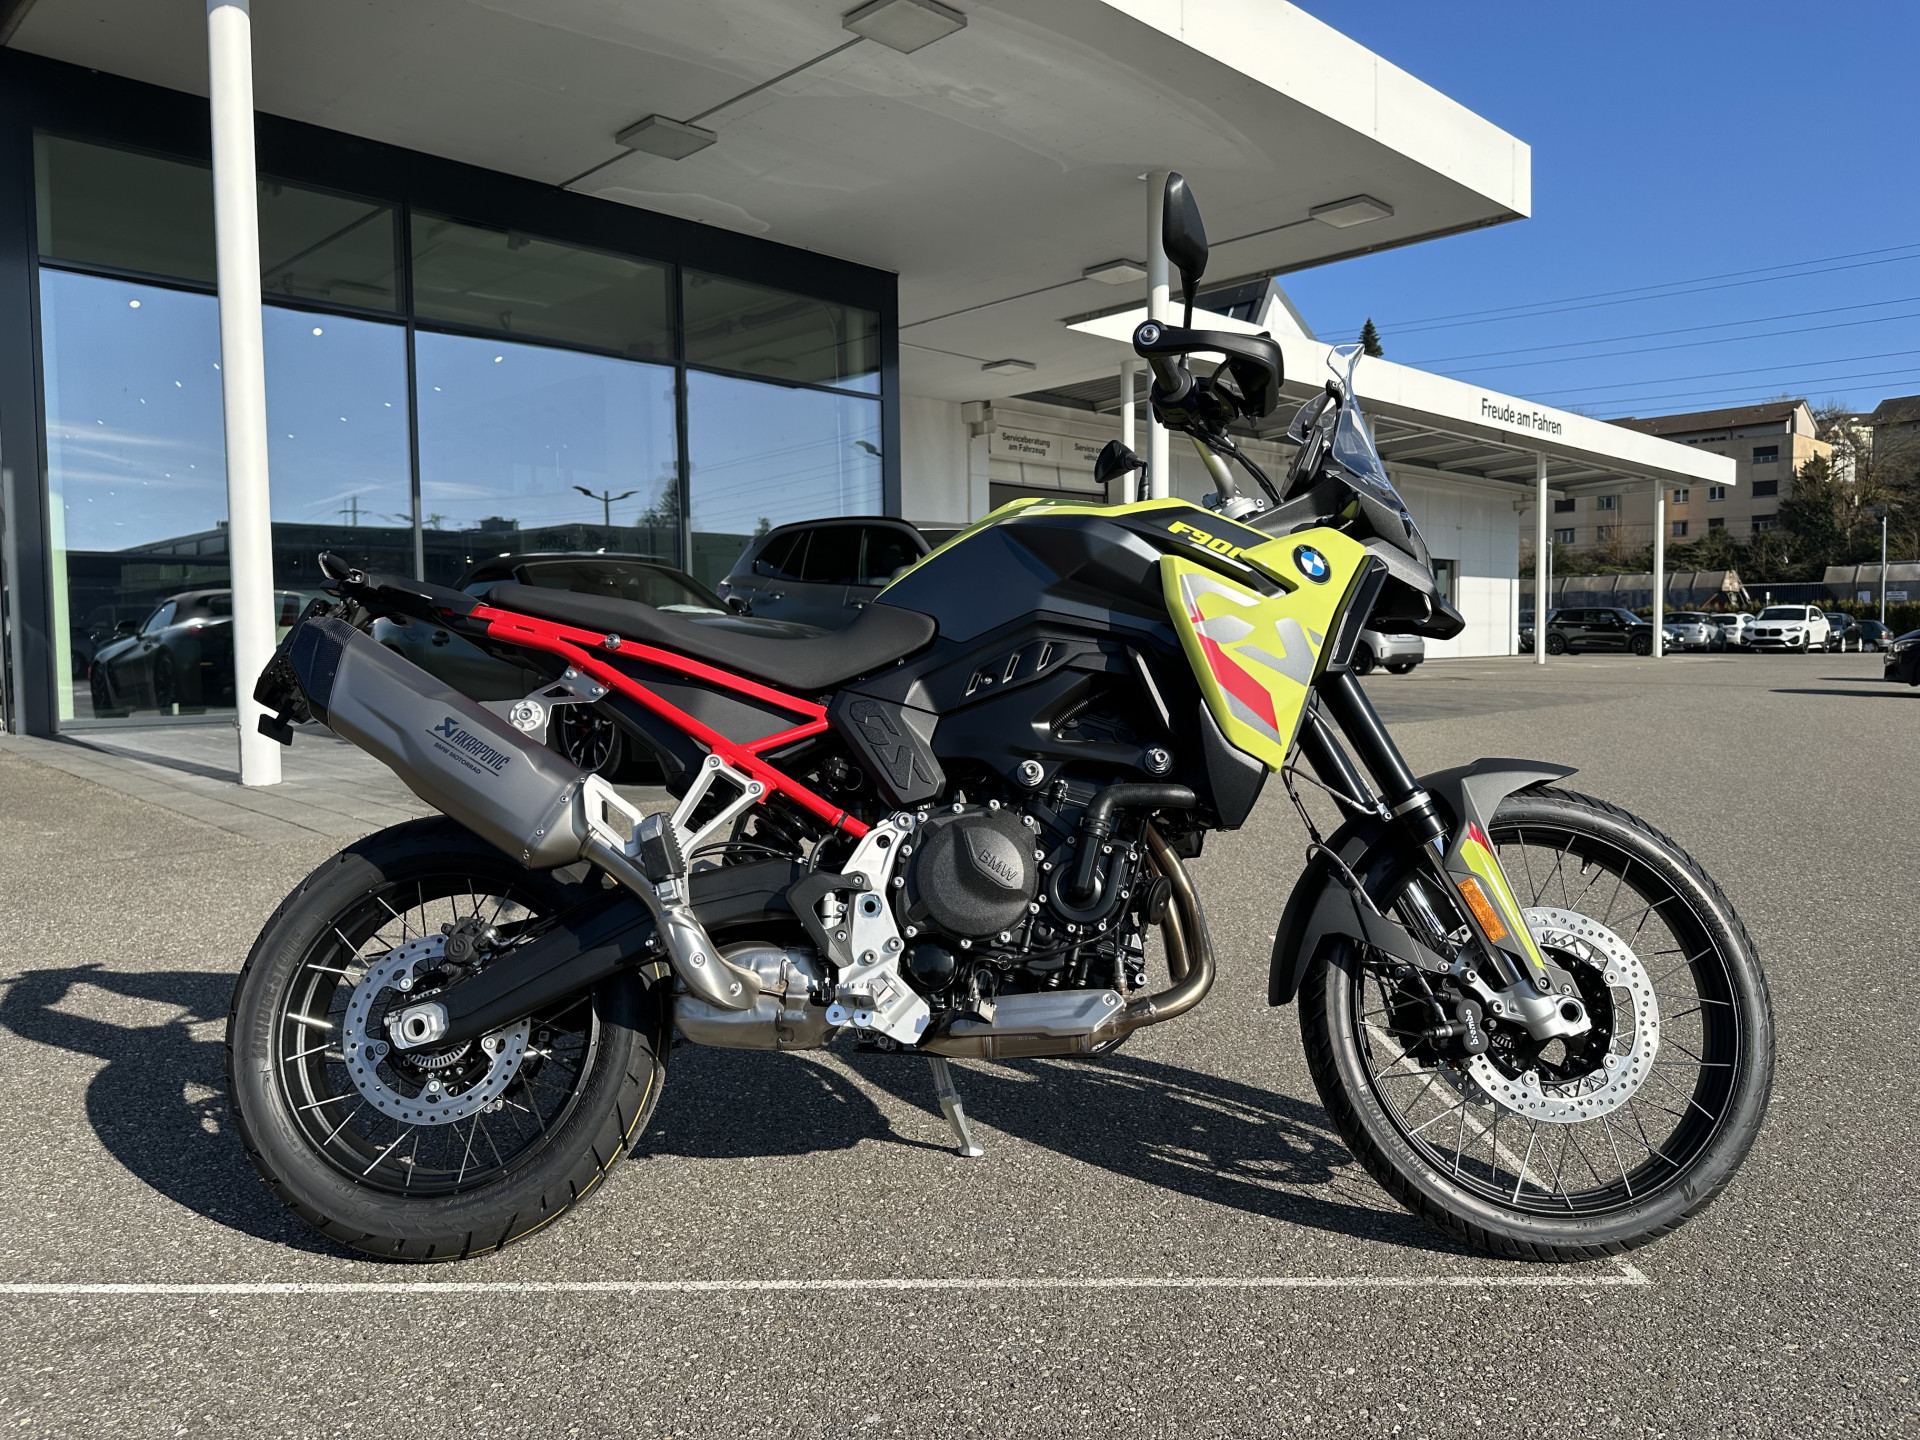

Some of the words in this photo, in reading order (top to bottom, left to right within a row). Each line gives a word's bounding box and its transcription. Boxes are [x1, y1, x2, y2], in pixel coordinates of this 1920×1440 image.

[1481, 397, 1515, 423] Freude
[1517, 412, 1531, 428] am
[1532, 411, 1562, 435] Fahren
[1002, 432, 1051, 448] Serviceberatung
[1019, 443, 1046, 456] Fahrzeug
[1074, 442, 1095, 453] Service
[433, 742, 450, 754] BMW
[449, 751, 482, 775] MOTORRAD
[450, 730, 511, 771] AKRAPOVIČ
[978, 849, 1018, 882] BMW
[1465, 1008, 1480, 1046] brembo
